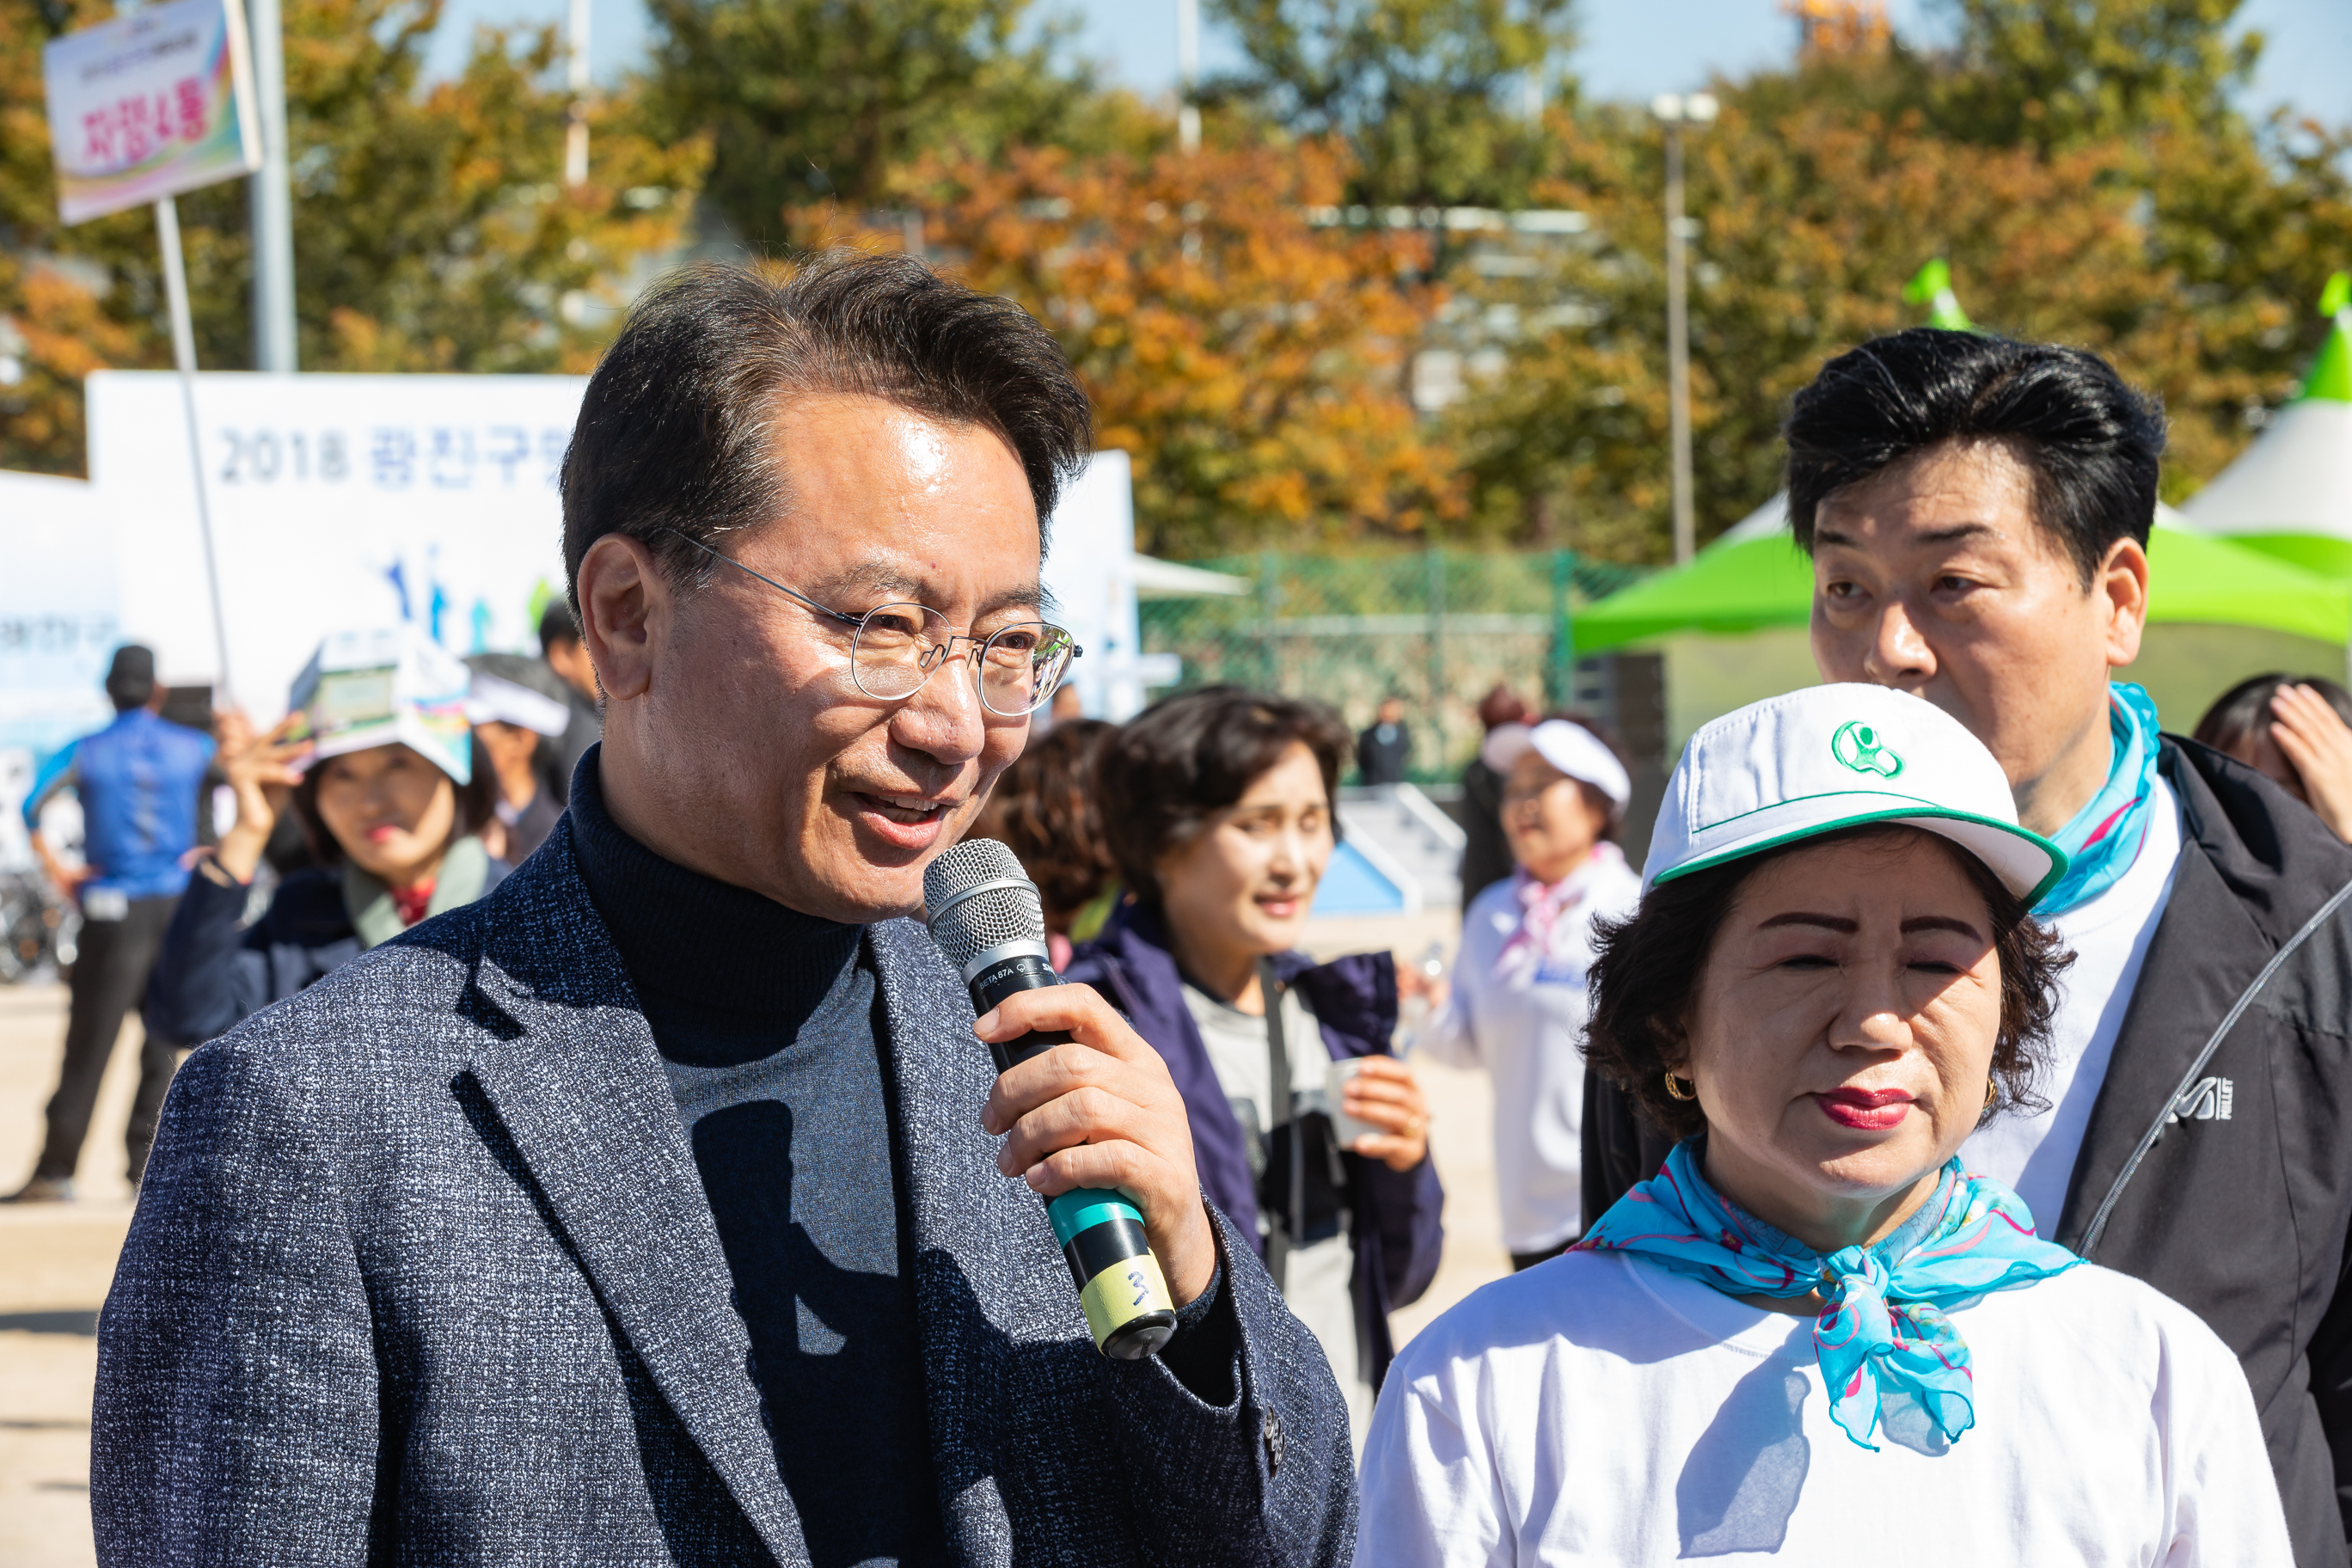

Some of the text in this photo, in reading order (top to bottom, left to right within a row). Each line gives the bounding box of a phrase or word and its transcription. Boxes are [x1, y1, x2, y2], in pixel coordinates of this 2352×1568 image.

[218, 426, 352, 486] 2018
[980, 968, 1014, 989] BETA 87A
[2220, 1077, 2233, 1120] MILLET
[1127, 1271, 1149, 1307] 3
